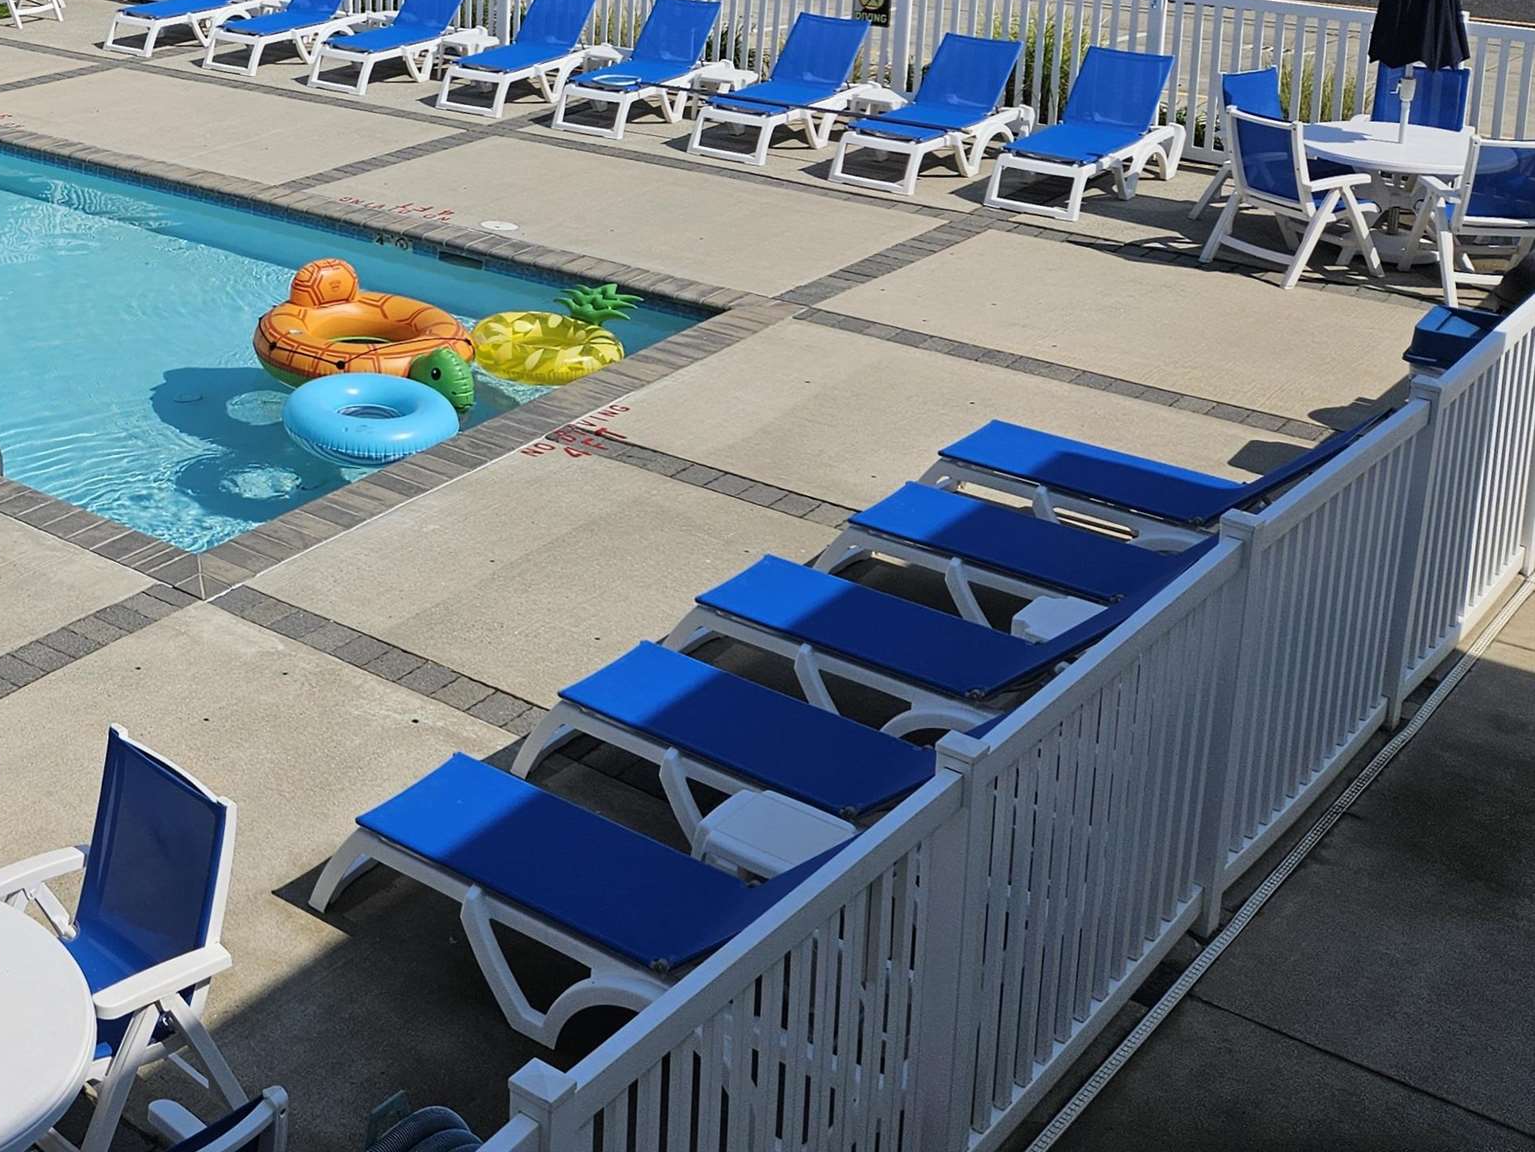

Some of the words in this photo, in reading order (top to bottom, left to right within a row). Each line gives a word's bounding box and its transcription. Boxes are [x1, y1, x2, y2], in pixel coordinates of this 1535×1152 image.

[855, 11, 888, 23] DIVING
[520, 442, 556, 457] NO
[555, 404, 630, 443] DIVING
